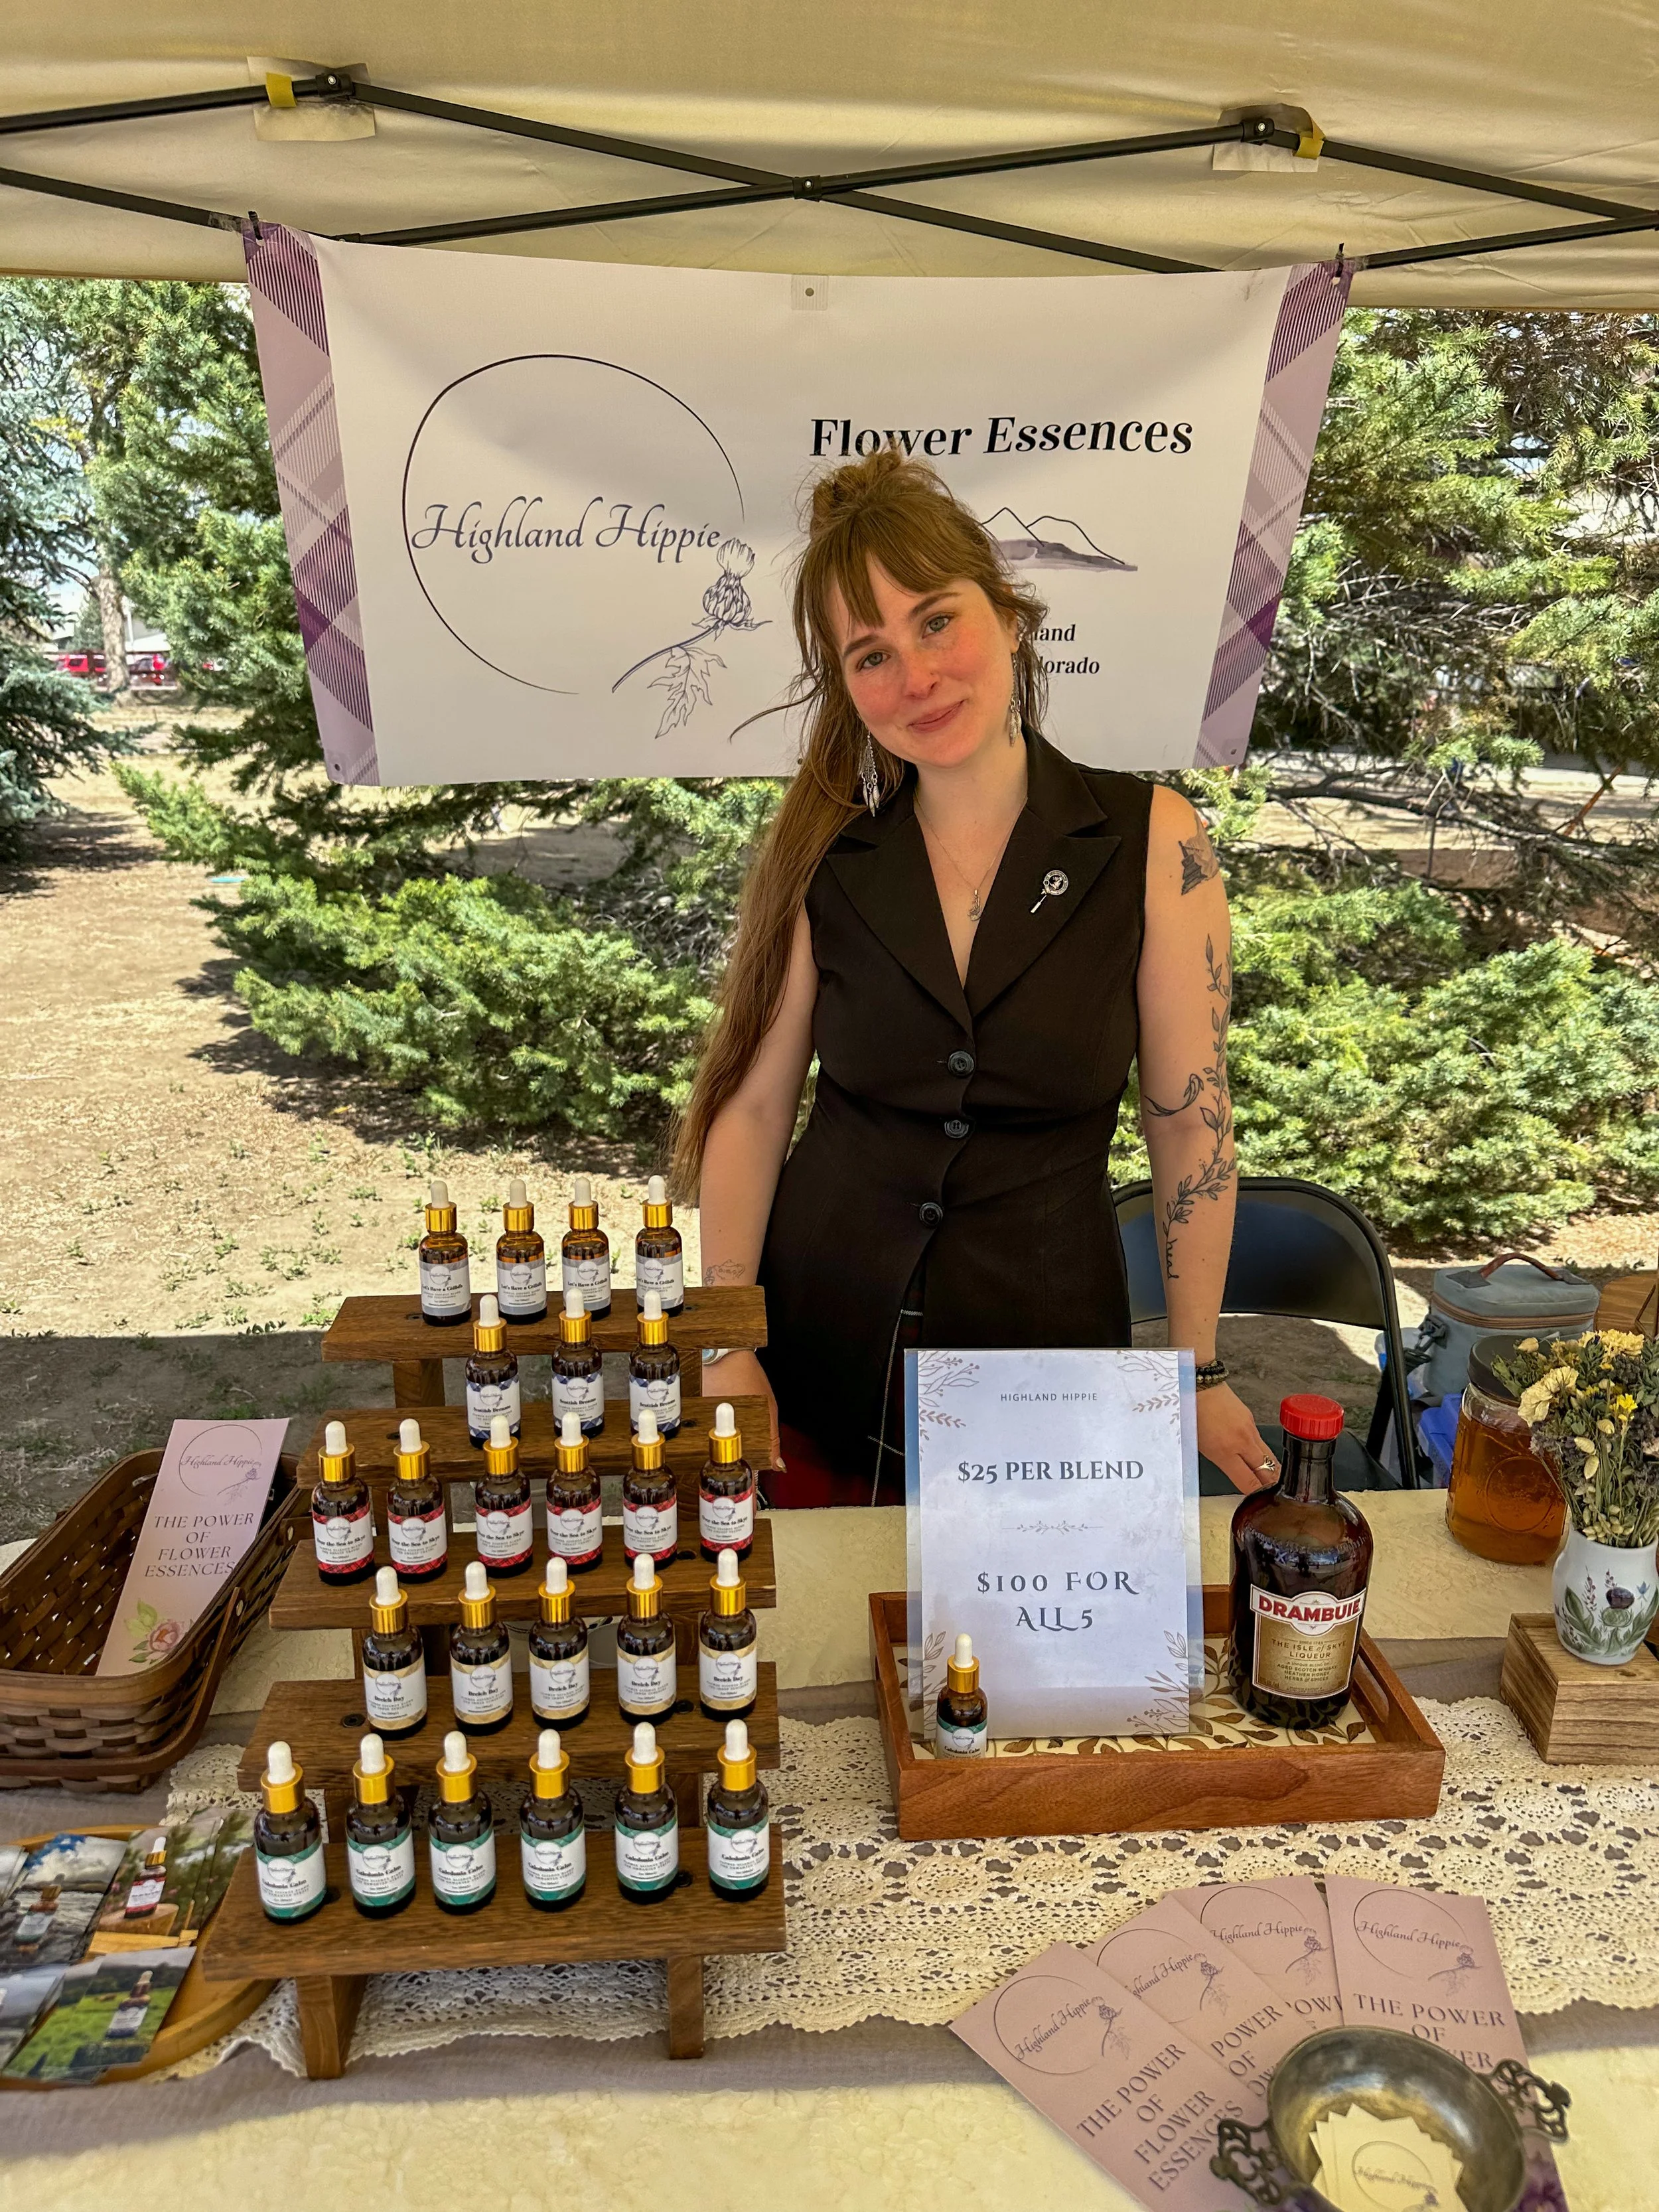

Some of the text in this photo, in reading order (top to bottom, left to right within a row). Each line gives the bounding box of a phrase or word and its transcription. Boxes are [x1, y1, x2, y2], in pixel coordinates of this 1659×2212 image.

[810, 417, 1192, 457] Flower Essences
[411, 496, 721, 564] Highland Hippie
[1000, 1392, 1098, 1402] HIGHLAND HIPPIE
[180, 1454, 254, 1469] Highland Hippie
[958, 1460, 1144, 1485] $25 PER BLEND
[155, 1512, 254, 1528] THE POWER
[186, 1531, 211, 1544] OF
[158, 1546, 231, 1561] FLOWER
[144, 1561, 236, 1578] ESSENCES
[977, 1571, 1140, 1595] $100 FOR
[1016, 1606, 1093, 1632] ALL 5
[1259, 1594, 1361, 1622] DRAMBUIE
[1271, 1639, 1289, 1649] THE
[1327, 1640, 1346, 1650] SKYE
[1210, 1921, 1303, 1943] Highland Hippie
[1356, 1921, 1460, 1949] Highland Hippie
[1127, 1954, 1194, 2000] ghland Hippie
[1353, 1993, 1403, 2016] THE
[1412, 2003, 1505, 2026] POWER
[1015, 1998, 1091, 2060] Highland Hippie
[1210, 2005, 1283, 2057] POWER
[1412, 2024, 1445, 2041] OF
[1229, 2050, 1256, 2076] OF
[1076, 2043, 1187, 2137] THE POWER
[1136, 2093, 1164, 2122] OF
[1134, 2091, 1215, 2164] FLOWER
[1148, 2100, 1243, 2191] ESSENCES
